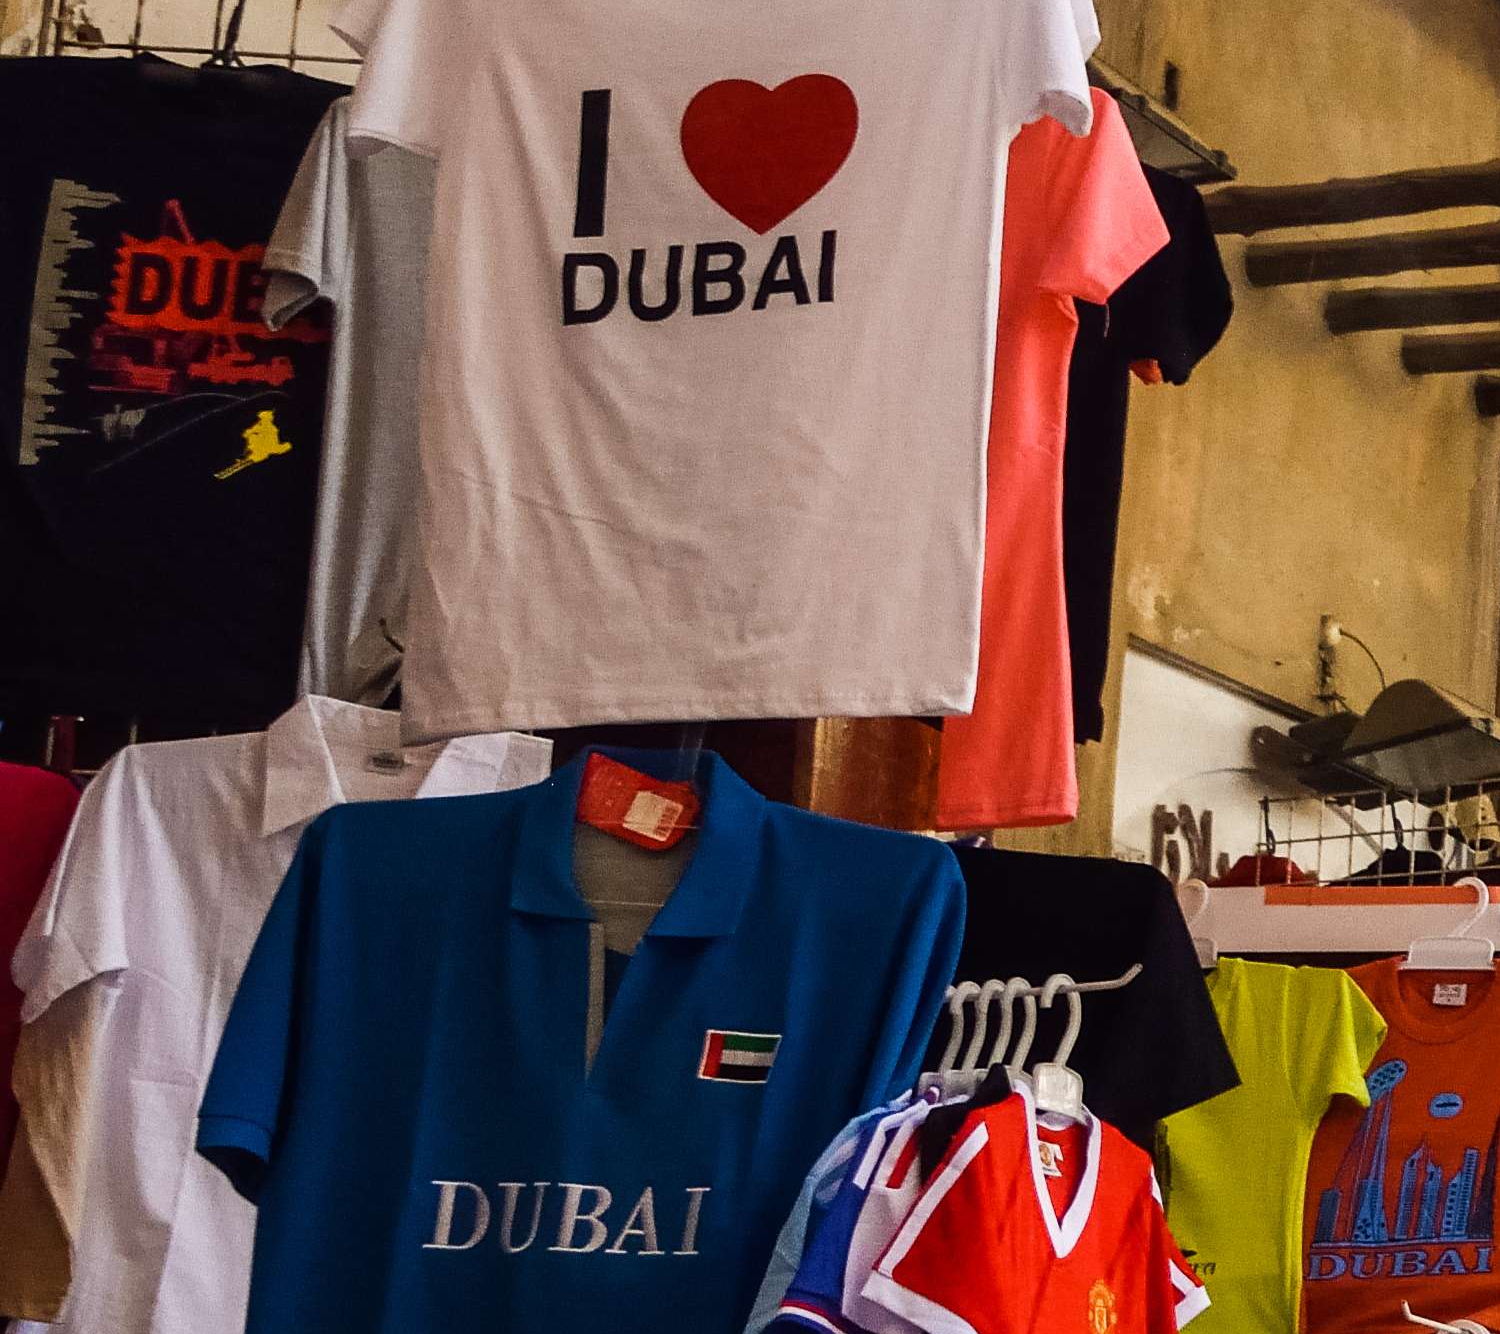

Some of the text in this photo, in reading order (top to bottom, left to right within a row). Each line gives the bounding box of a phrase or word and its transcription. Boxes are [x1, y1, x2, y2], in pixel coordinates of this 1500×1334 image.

[572, 88, 612, 239] I
[123, 251, 266, 321] DUB
[561, 229, 838, 327] DUBAI
[421, 1178, 713, 1258] DUBAI
[1303, 1244, 1496, 1282] DUBAI
